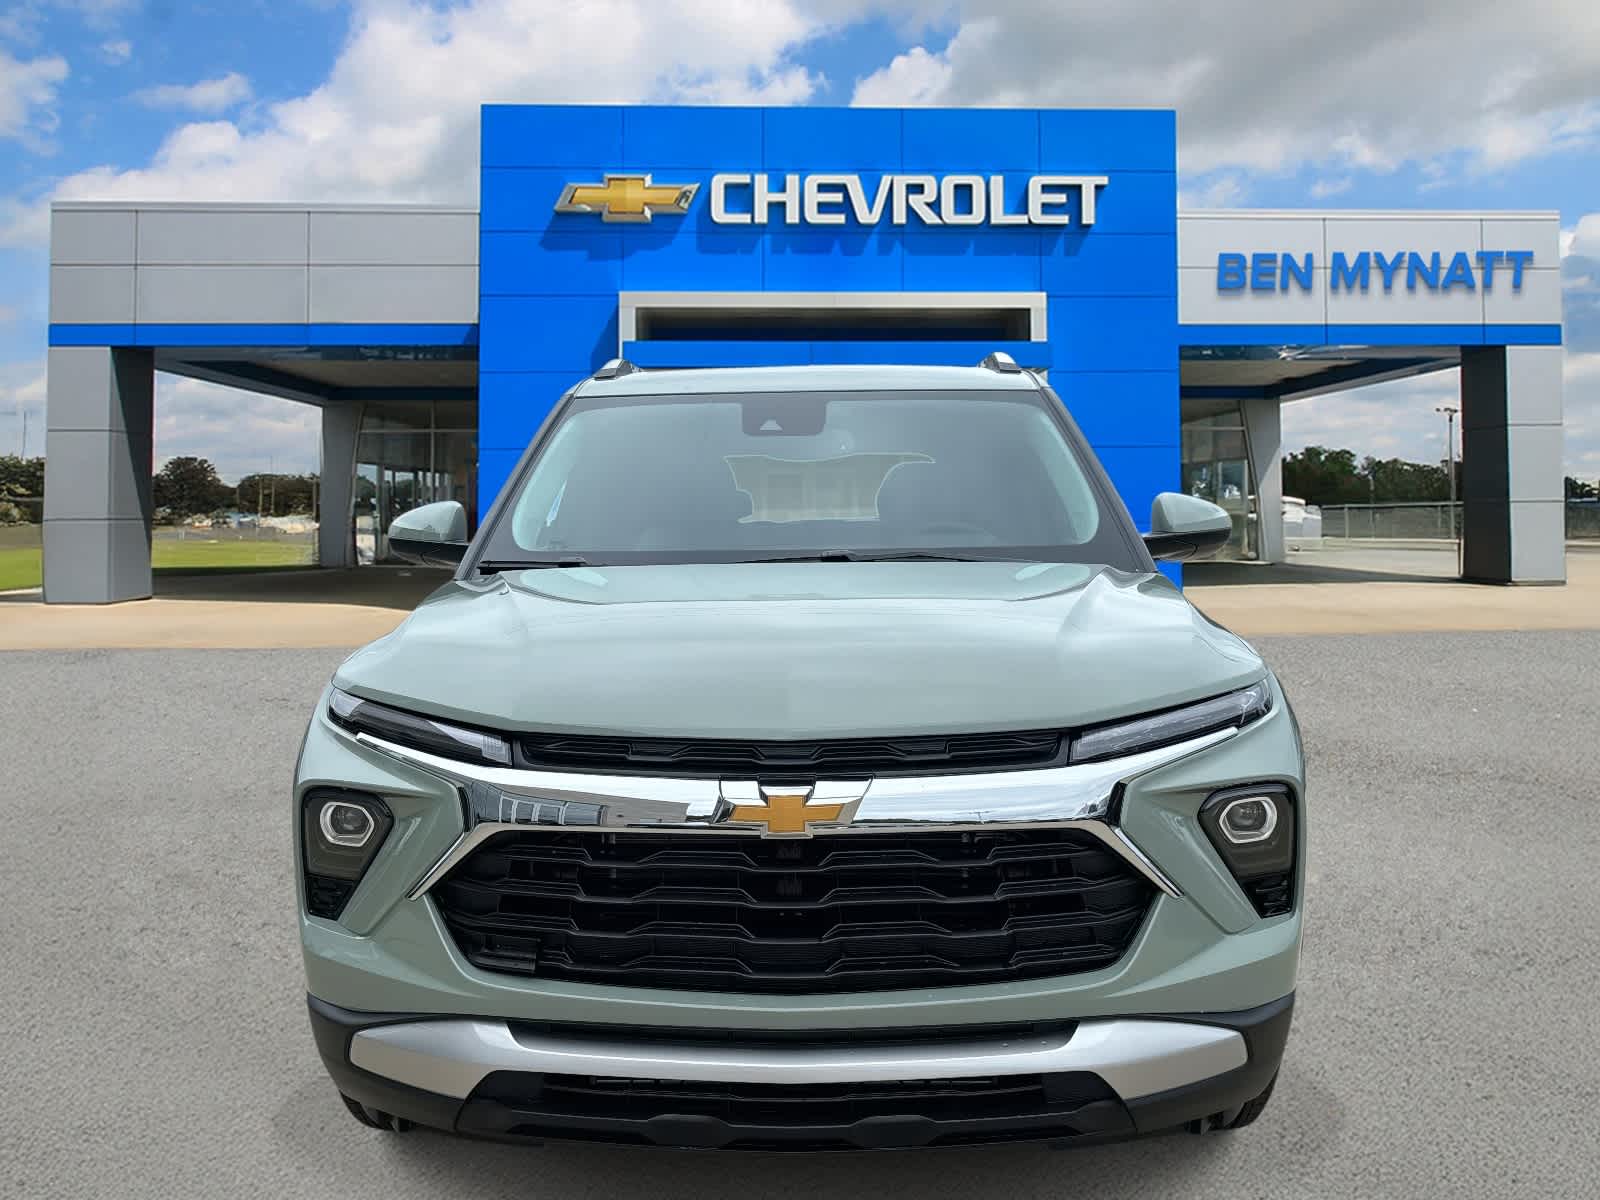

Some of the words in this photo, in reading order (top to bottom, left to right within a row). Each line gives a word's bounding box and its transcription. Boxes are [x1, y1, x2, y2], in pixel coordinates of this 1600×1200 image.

[710, 173, 1109, 226] CHEVROLET
[1217, 252, 1313, 291] BEN
[1330, 250, 1534, 291] MYNATT
